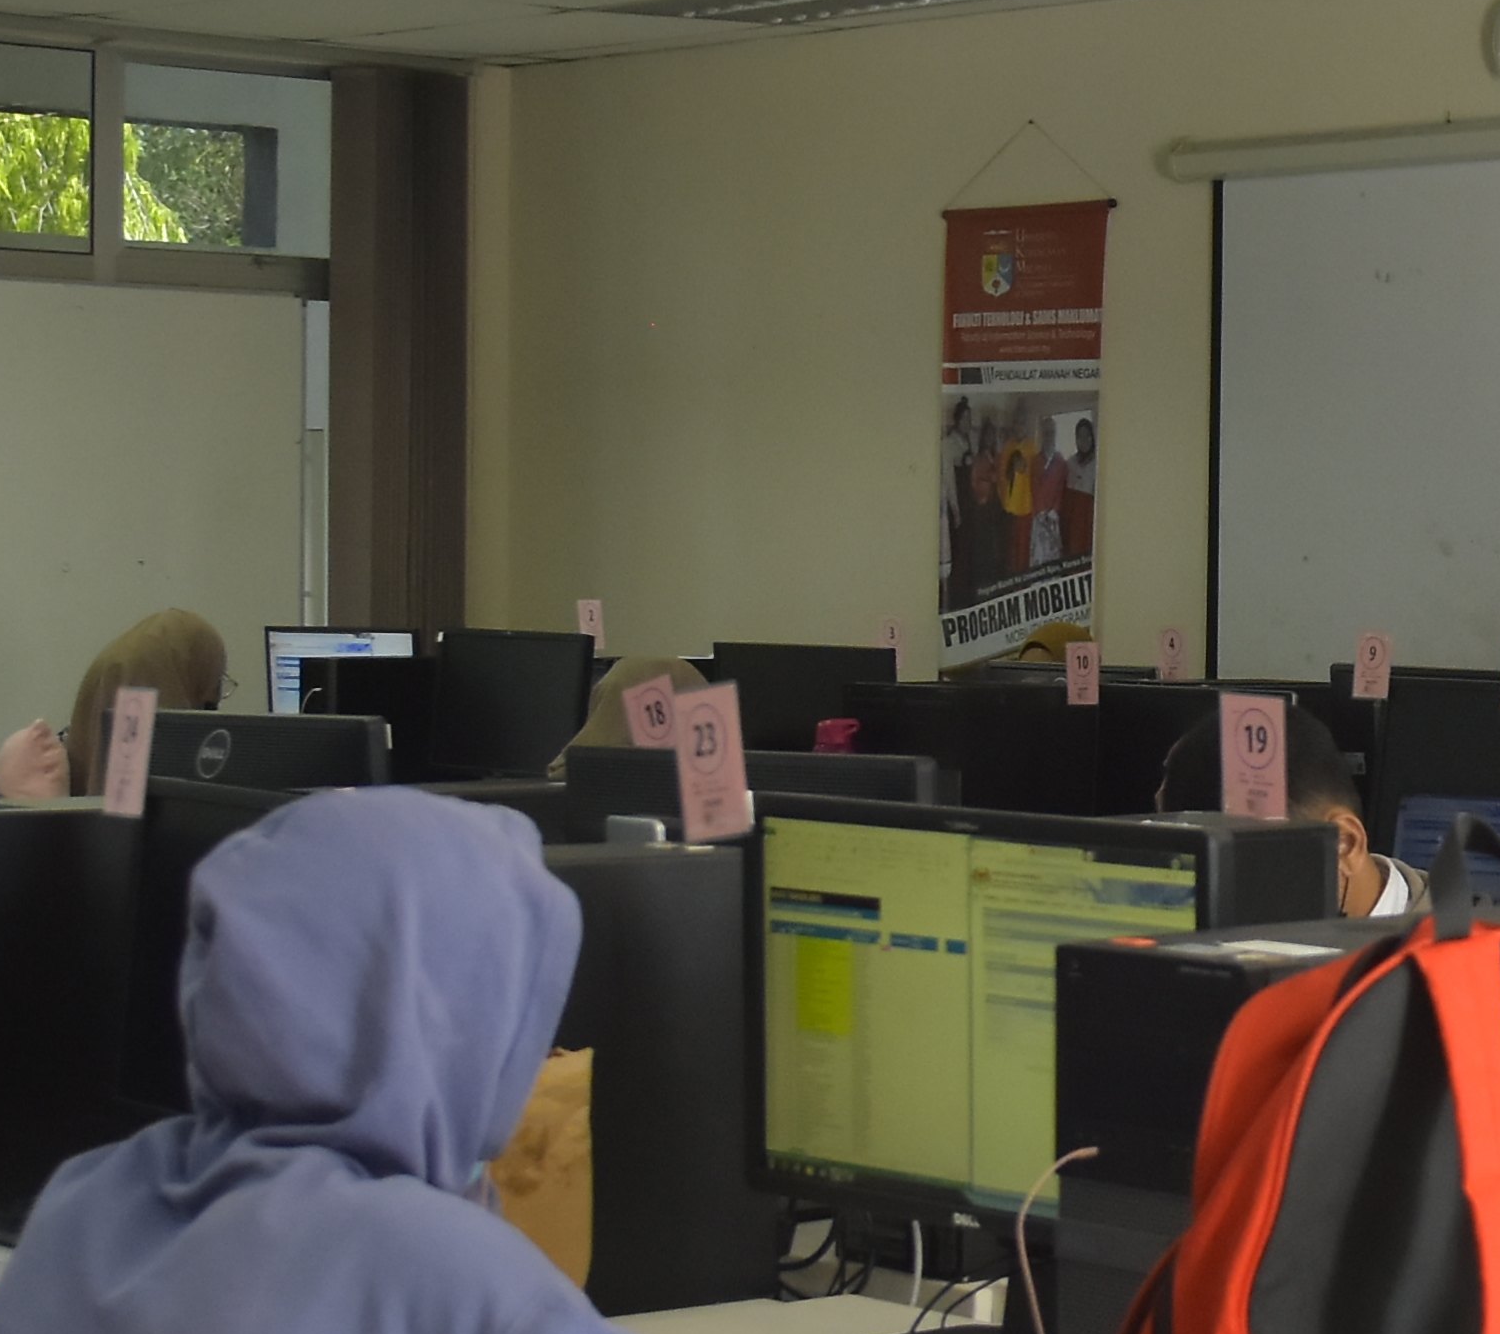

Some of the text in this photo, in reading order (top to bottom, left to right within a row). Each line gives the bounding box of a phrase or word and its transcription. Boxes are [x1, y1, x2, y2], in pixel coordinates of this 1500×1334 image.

[941, 595, 1022, 648] PROGRAM
[1076, 655, 1090, 670] 10
[1368, 645, 1377, 661] 9
[643, 700, 666, 729] 18
[1244, 725, 1268, 754] 19
